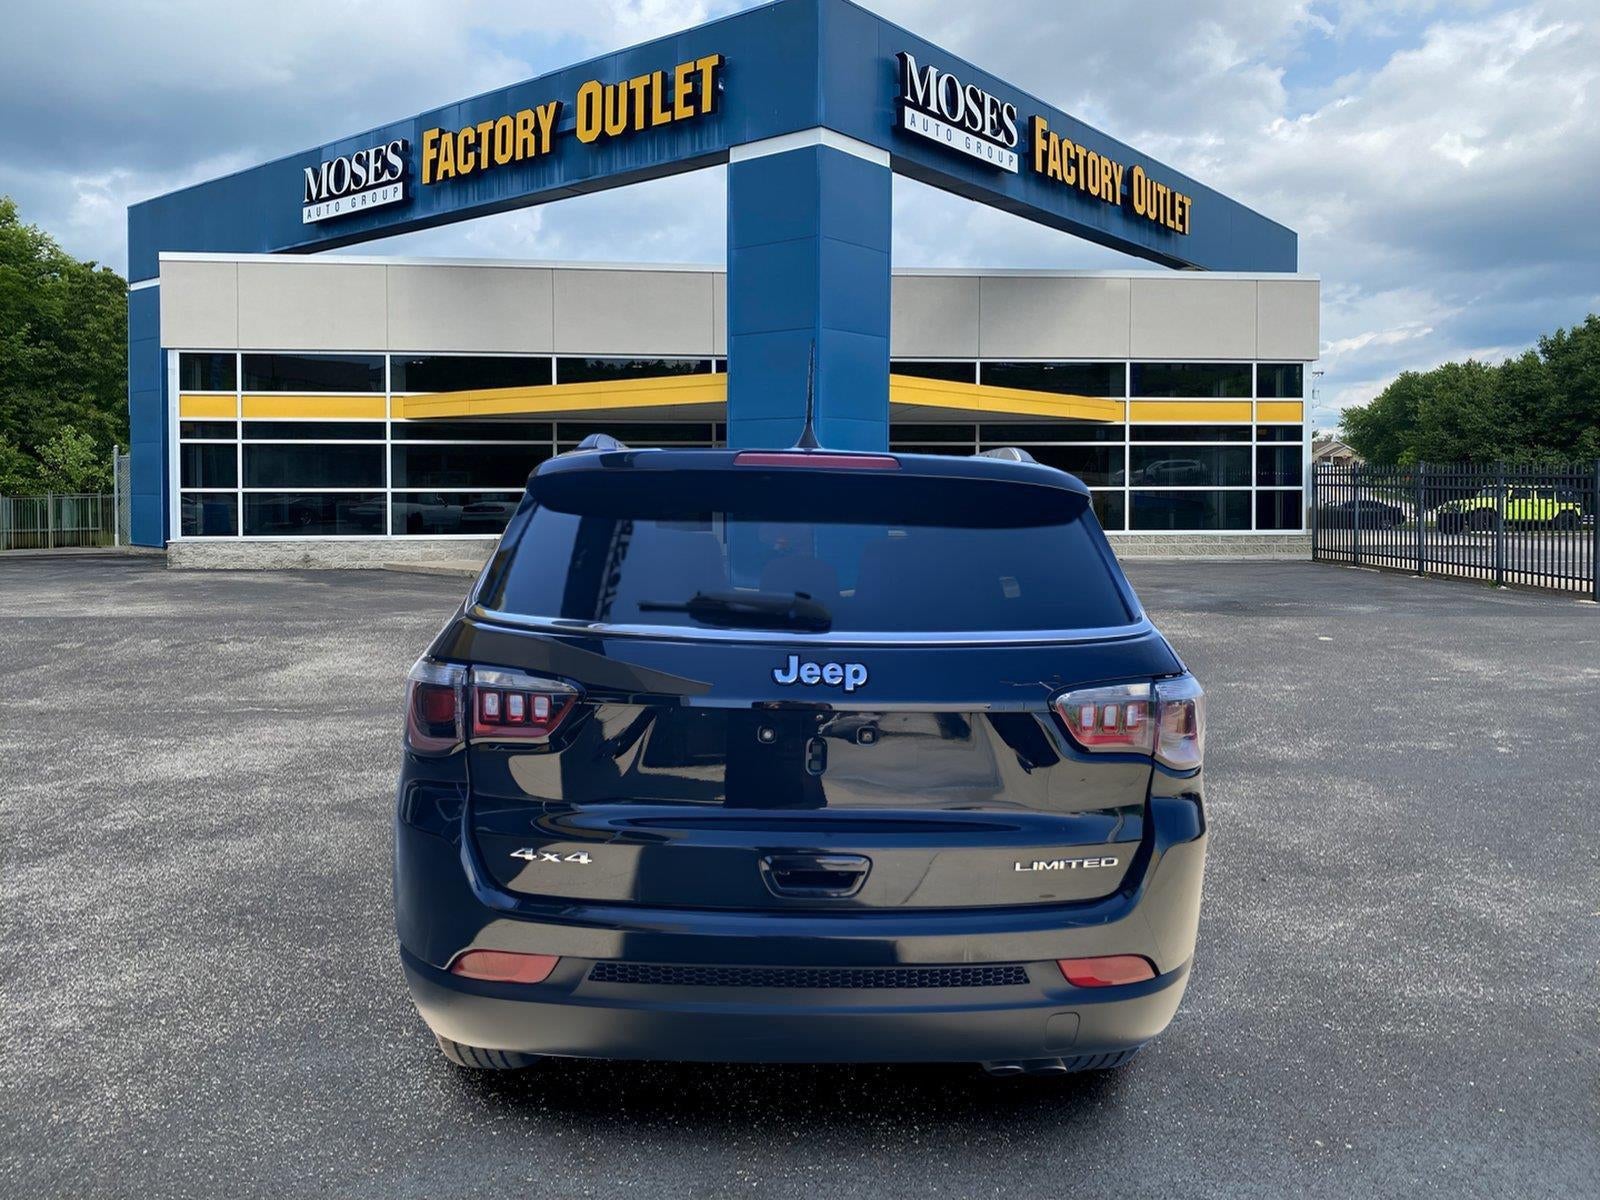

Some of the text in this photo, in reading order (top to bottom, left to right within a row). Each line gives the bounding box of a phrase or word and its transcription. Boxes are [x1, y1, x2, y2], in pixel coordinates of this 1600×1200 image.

[421, 53, 721, 185] FACTORY OUTLET
[903, 52, 1018, 148] MOSES
[909, 113, 1014, 167] AUTO GROUP
[303, 139, 404, 203] MOSES
[1034, 114, 1192, 236] FACTORY OUTLET
[306, 186, 400, 220] AUTO GROUP
[773, 655, 868, 691] Jeep
[509, 847, 593, 864] 4x4
[1014, 857, 1119, 872] LIMITED
